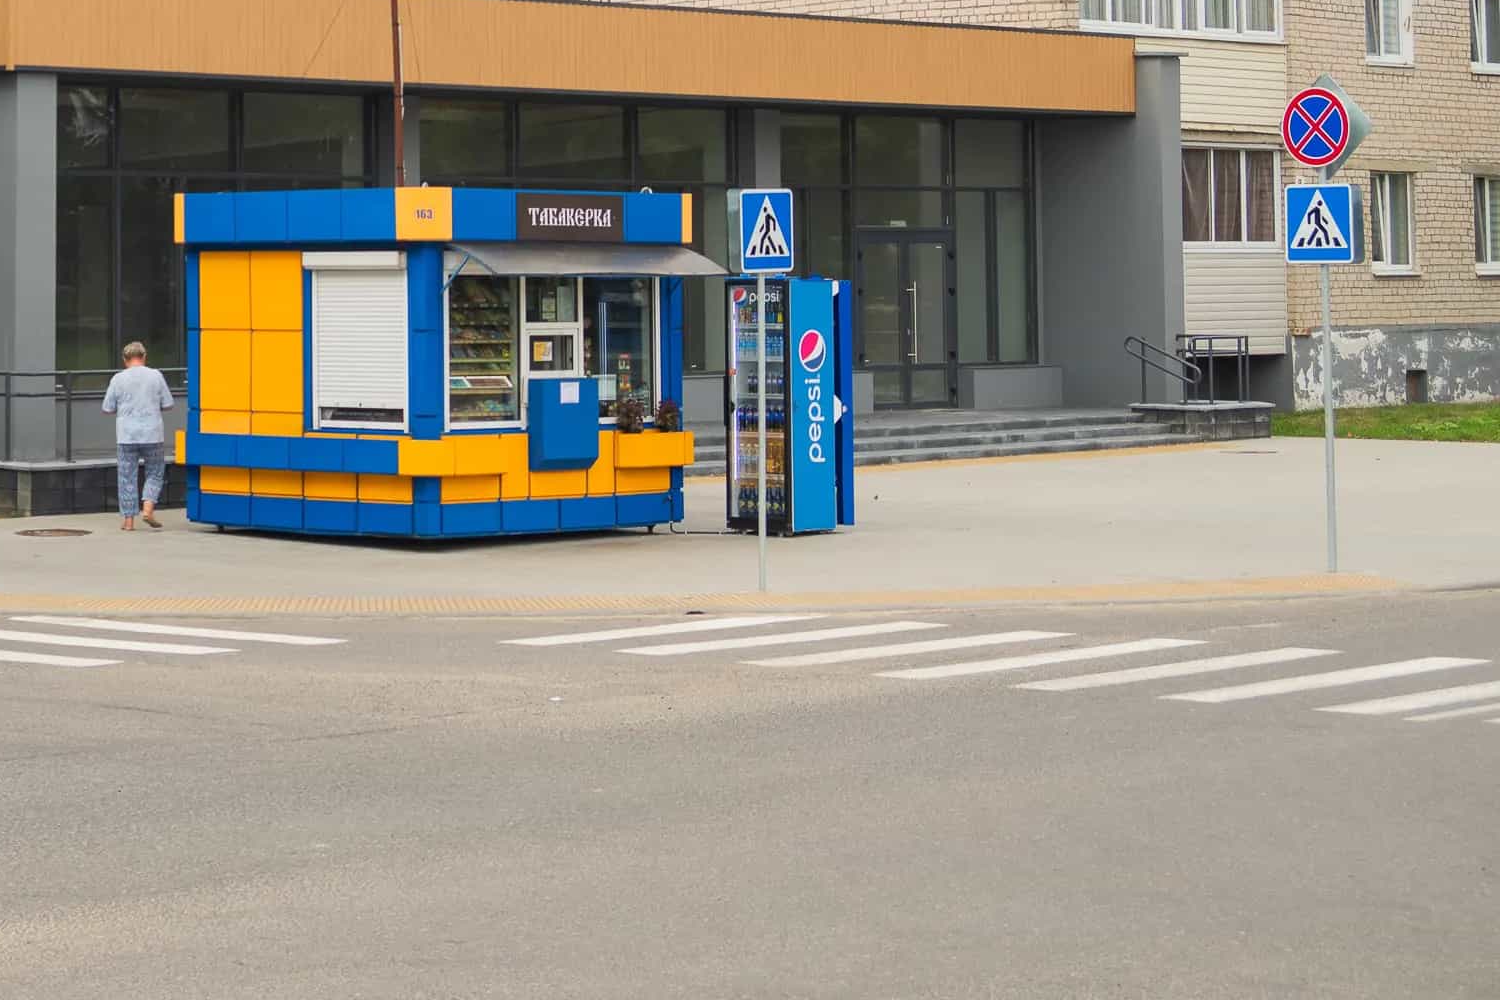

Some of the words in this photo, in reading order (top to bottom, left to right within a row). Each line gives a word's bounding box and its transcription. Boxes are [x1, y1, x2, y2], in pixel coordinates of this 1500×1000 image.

[415, 208, 433, 220] 163
[528, 207, 612, 227] ТАБАКЕРКА
[749, 290, 779, 304] ppsi
[805, 376, 826, 463] pepsi
